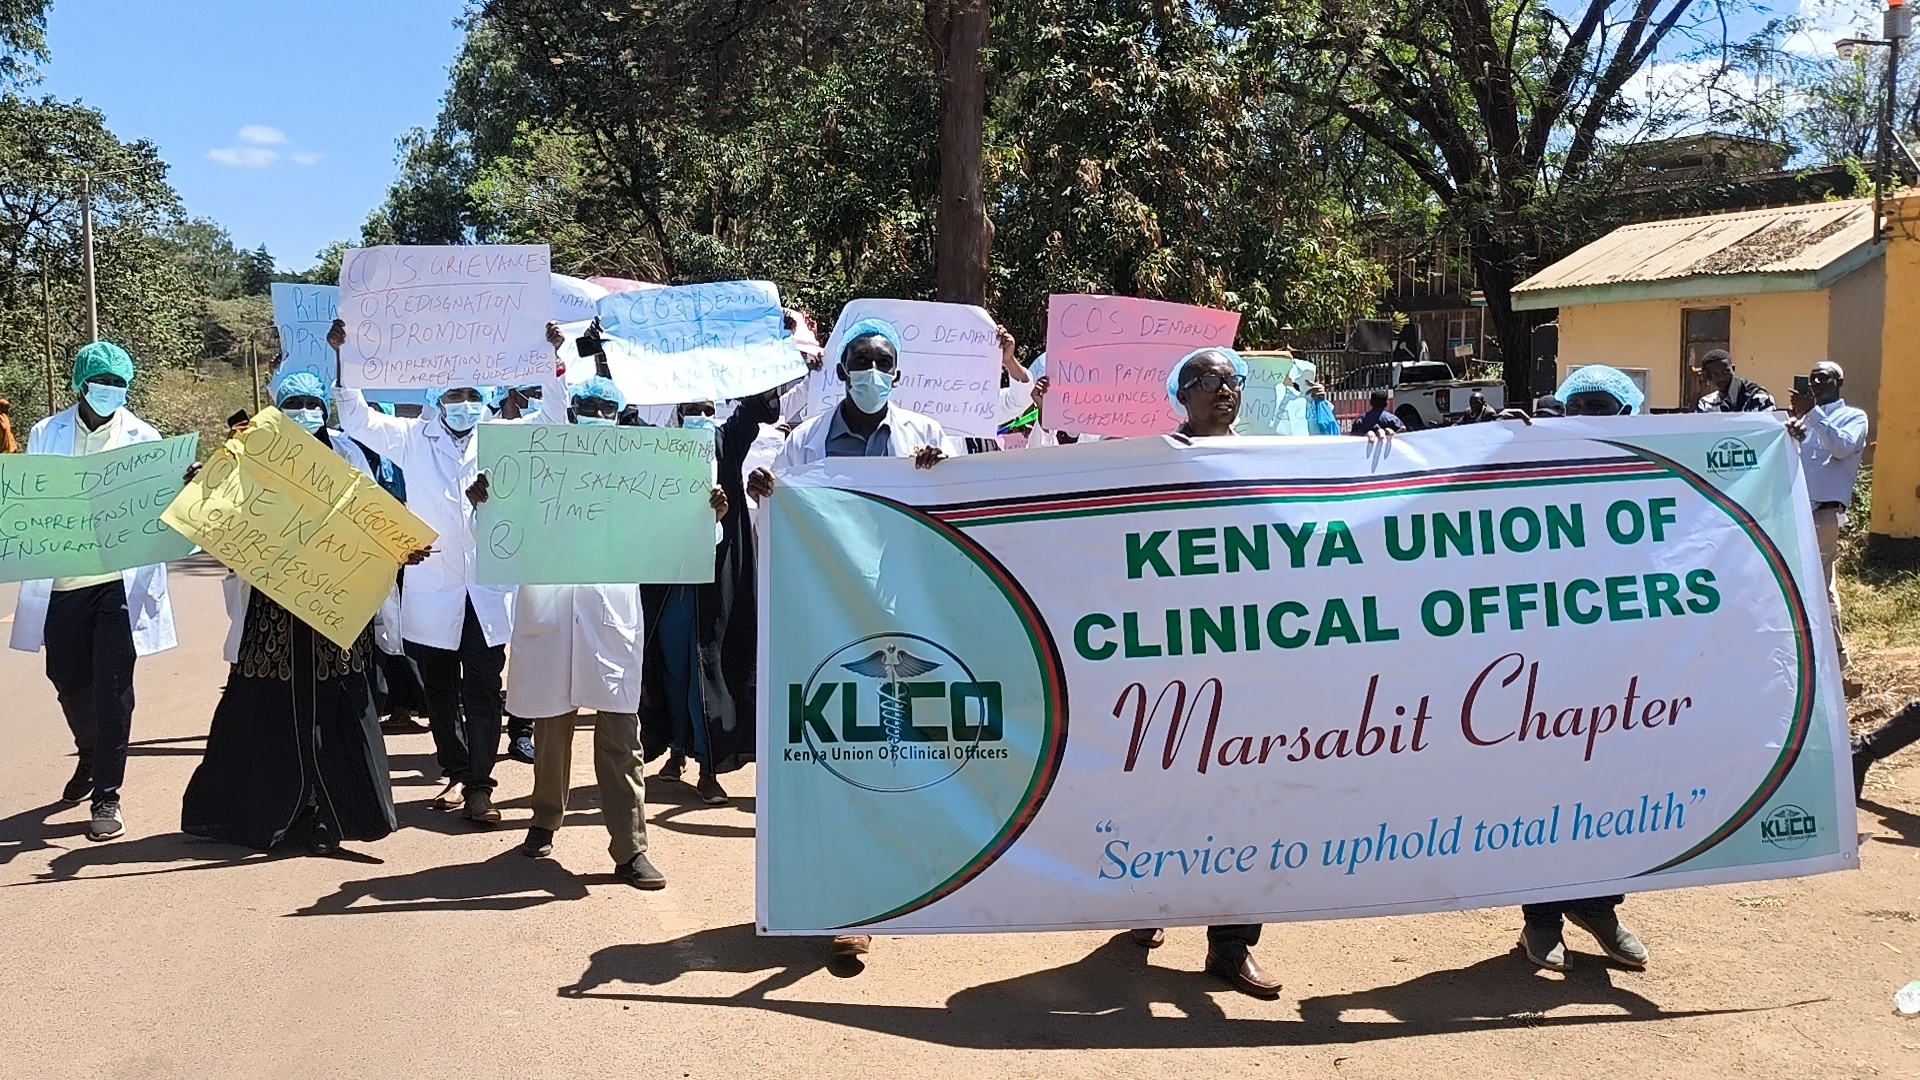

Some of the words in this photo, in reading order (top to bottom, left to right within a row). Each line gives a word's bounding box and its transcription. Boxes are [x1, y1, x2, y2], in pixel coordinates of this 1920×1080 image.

[431, 252, 549, 278] GRIEVANCES
[384, 287, 523, 319] REDISGNATION
[388, 316, 511, 354] PROMOTION
[1140, 314, 1227, 340] DEMAND
[397, 370, 465, 385] CAREER
[471, 362, 553, 383] GUIDELINES
[485, 351, 507, 370] OF
[516, 350, 548, 365] NEW
[1062, 391, 1157, 405] ALLOWANCES
[1062, 408, 1137, 427] SCHEME
[244, 421, 303, 476] OUR
[300, 461, 350, 507] NON
[1706, 448, 1758, 469] KUCO
[1, 462, 49, 505] WE
[529, 455, 568, 509] PAY
[575, 470, 681, 500] SALARIES
[0, 486, 176, 539] COMPREHENSIVE
[540, 496, 606, 526] TIME
[0, 529, 133, 561] INSURANCE
[222, 473, 277, 517] WE
[279, 503, 382, 588] WANT
[1125, 519, 1364, 580] KENYA
[1384, 503, 1586, 561] UNION
[1605, 496, 1677, 545] OF
[188, 497, 350, 606] COMPREHENSIVE
[194, 522, 287, 596] MEDICAL
[1073, 595, 1400, 661] CLINICAL
[1421, 568, 1721, 637] OFFICERS
[788, 681, 1004, 744] KUCO
[1112, 673, 1433, 775] Marsabit
[1460, 652, 1692, 762] Chapter
[783, 747, 827, 765] Kenya
[831, 746, 874, 760] Union
[899, 744, 951, 760] Clinical
[954, 744, 1009, 760] Officers
[1269, 838, 1309, 872] to
[1321, 815, 1462, 876] uphold
[1474, 804, 1560, 853] total
[1760, 816, 1817, 838] KUCO
